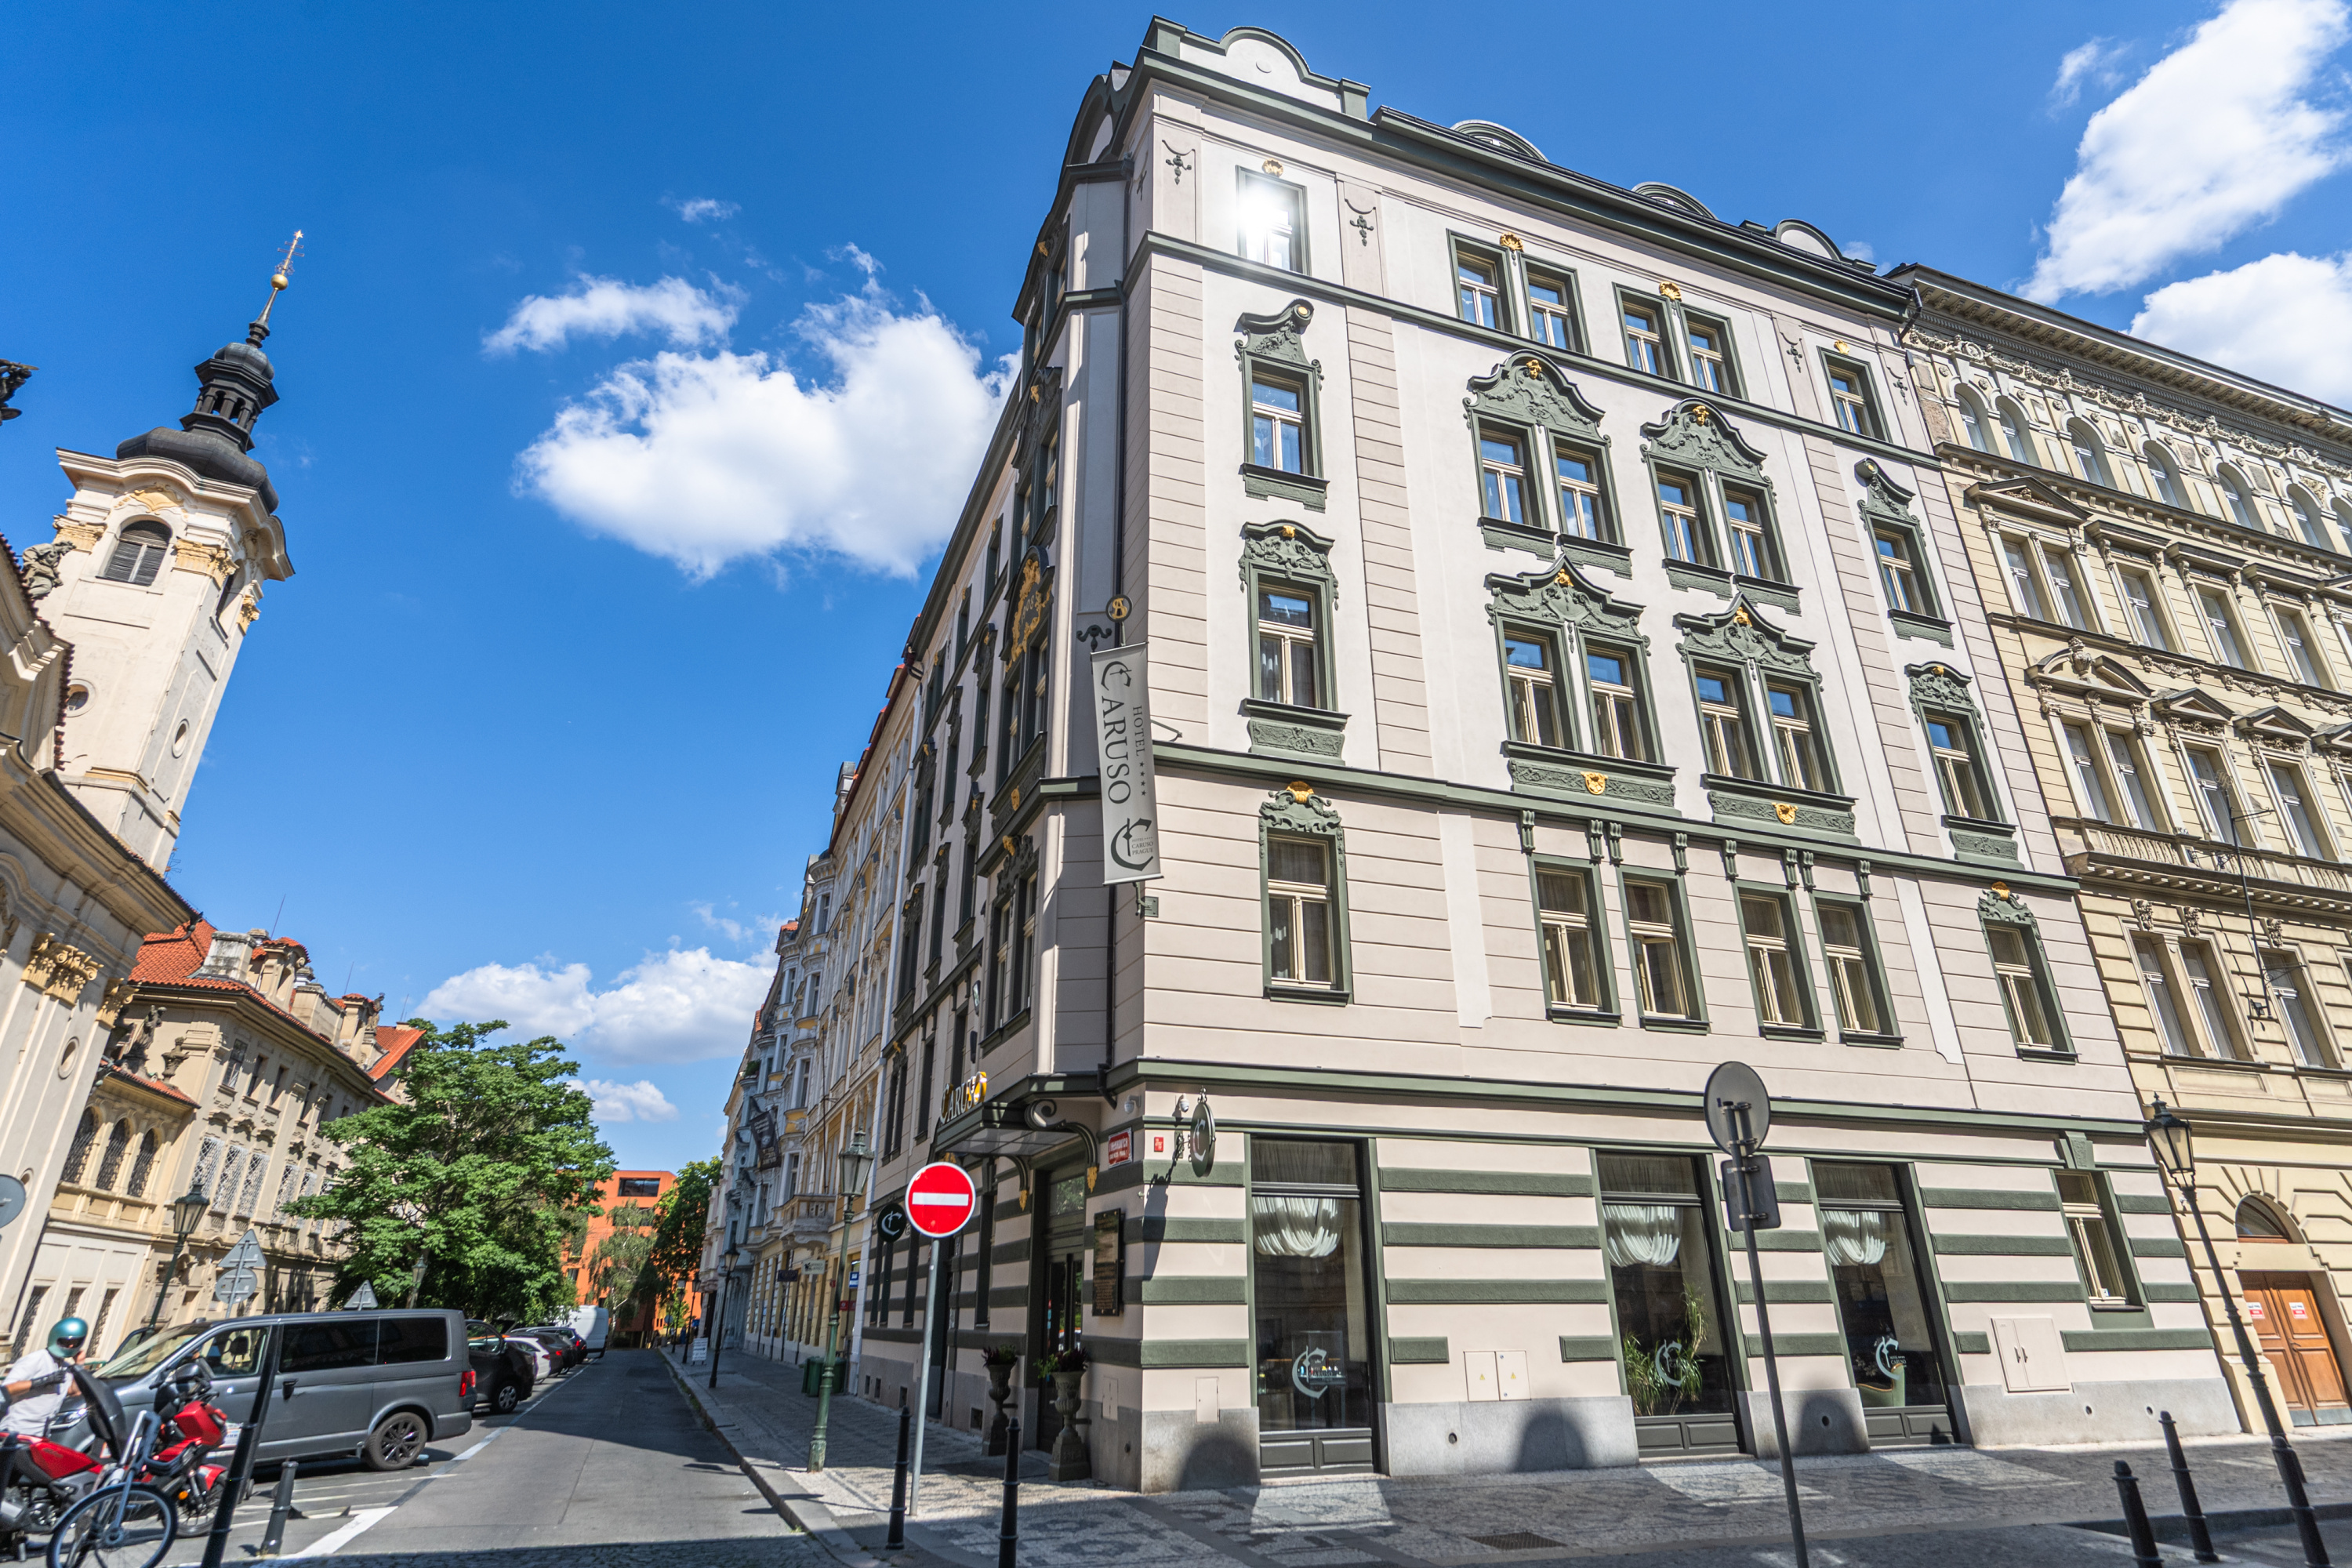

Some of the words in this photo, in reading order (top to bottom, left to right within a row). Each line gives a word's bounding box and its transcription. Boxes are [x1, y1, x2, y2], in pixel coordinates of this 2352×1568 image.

[1101, 661, 1132, 804] CARUSO
[1133, 705, 1145, 757] HOTEL
[940, 1071, 986, 1124] CARUSO
